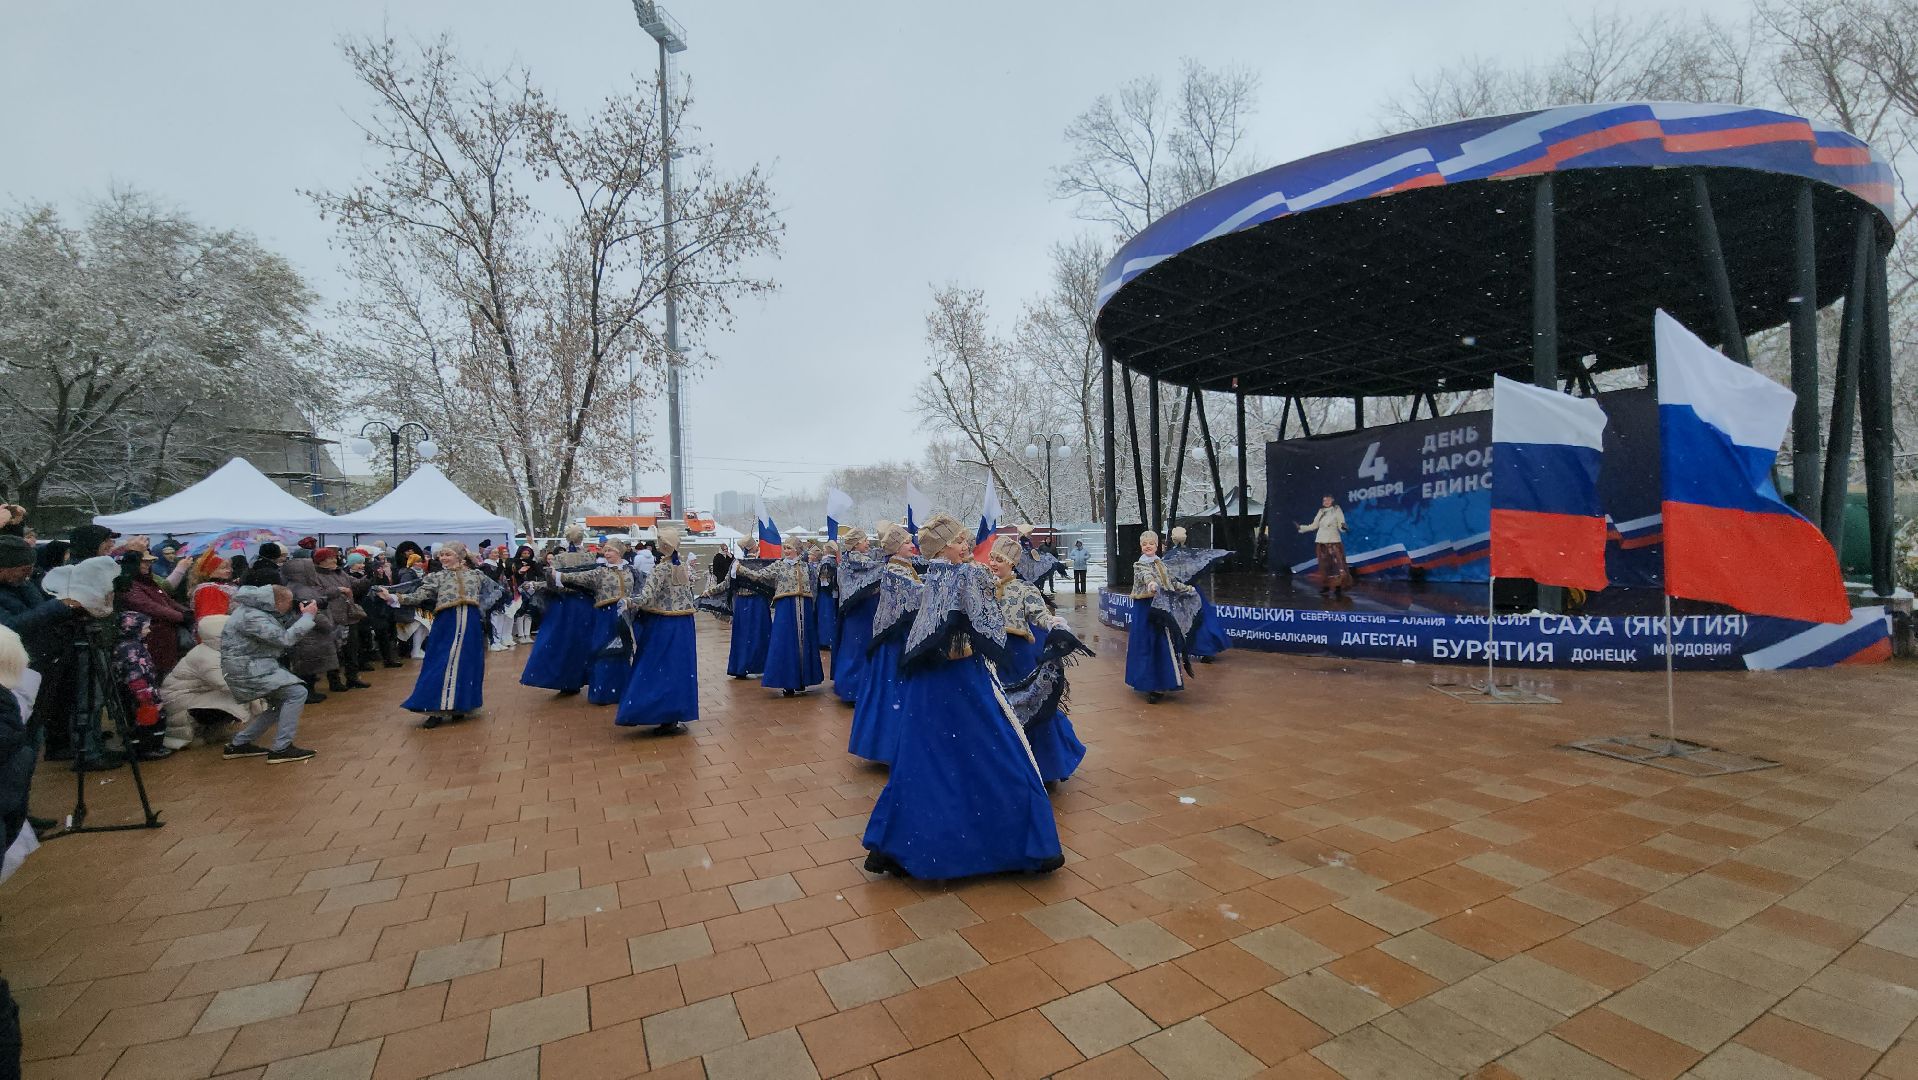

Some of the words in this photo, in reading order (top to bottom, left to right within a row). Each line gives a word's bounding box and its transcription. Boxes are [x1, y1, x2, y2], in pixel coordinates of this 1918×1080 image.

[1422, 426, 1479, 454] ДЕНЬ
[1358, 441, 1388, 482] 4
[1348, 481, 1404, 502] НОЯБРЯ
[1422, 472, 1493, 499] ЕДИНС
[1215, 605, 1294, 622] КАЛМЫКИЯ
[1301, 611, 1346, 623] СЕВЕРНАЯ
[1349, 614, 1386, 625] ОСЕТИЯ
[1402, 615, 1446, 627] АЛАНИЯ
[1455, 614, 1530, 626] ХАКАСИЯ
[1540, 615, 1614, 636] САХА
[1624, 614, 1748, 638] (ЯКУТИЯ)
[1224, 629, 1328, 645] АБАРДИНО-БАЛКАРИЯ
[1341, 632, 1417, 648] ДАГЕСТАН
[1433, 638, 1554, 662] БУРЯТИЯ
[1571, 648, 1637, 663] ДОНЕЦК
[1653, 643, 1732, 656] МОРДОВИЯ
